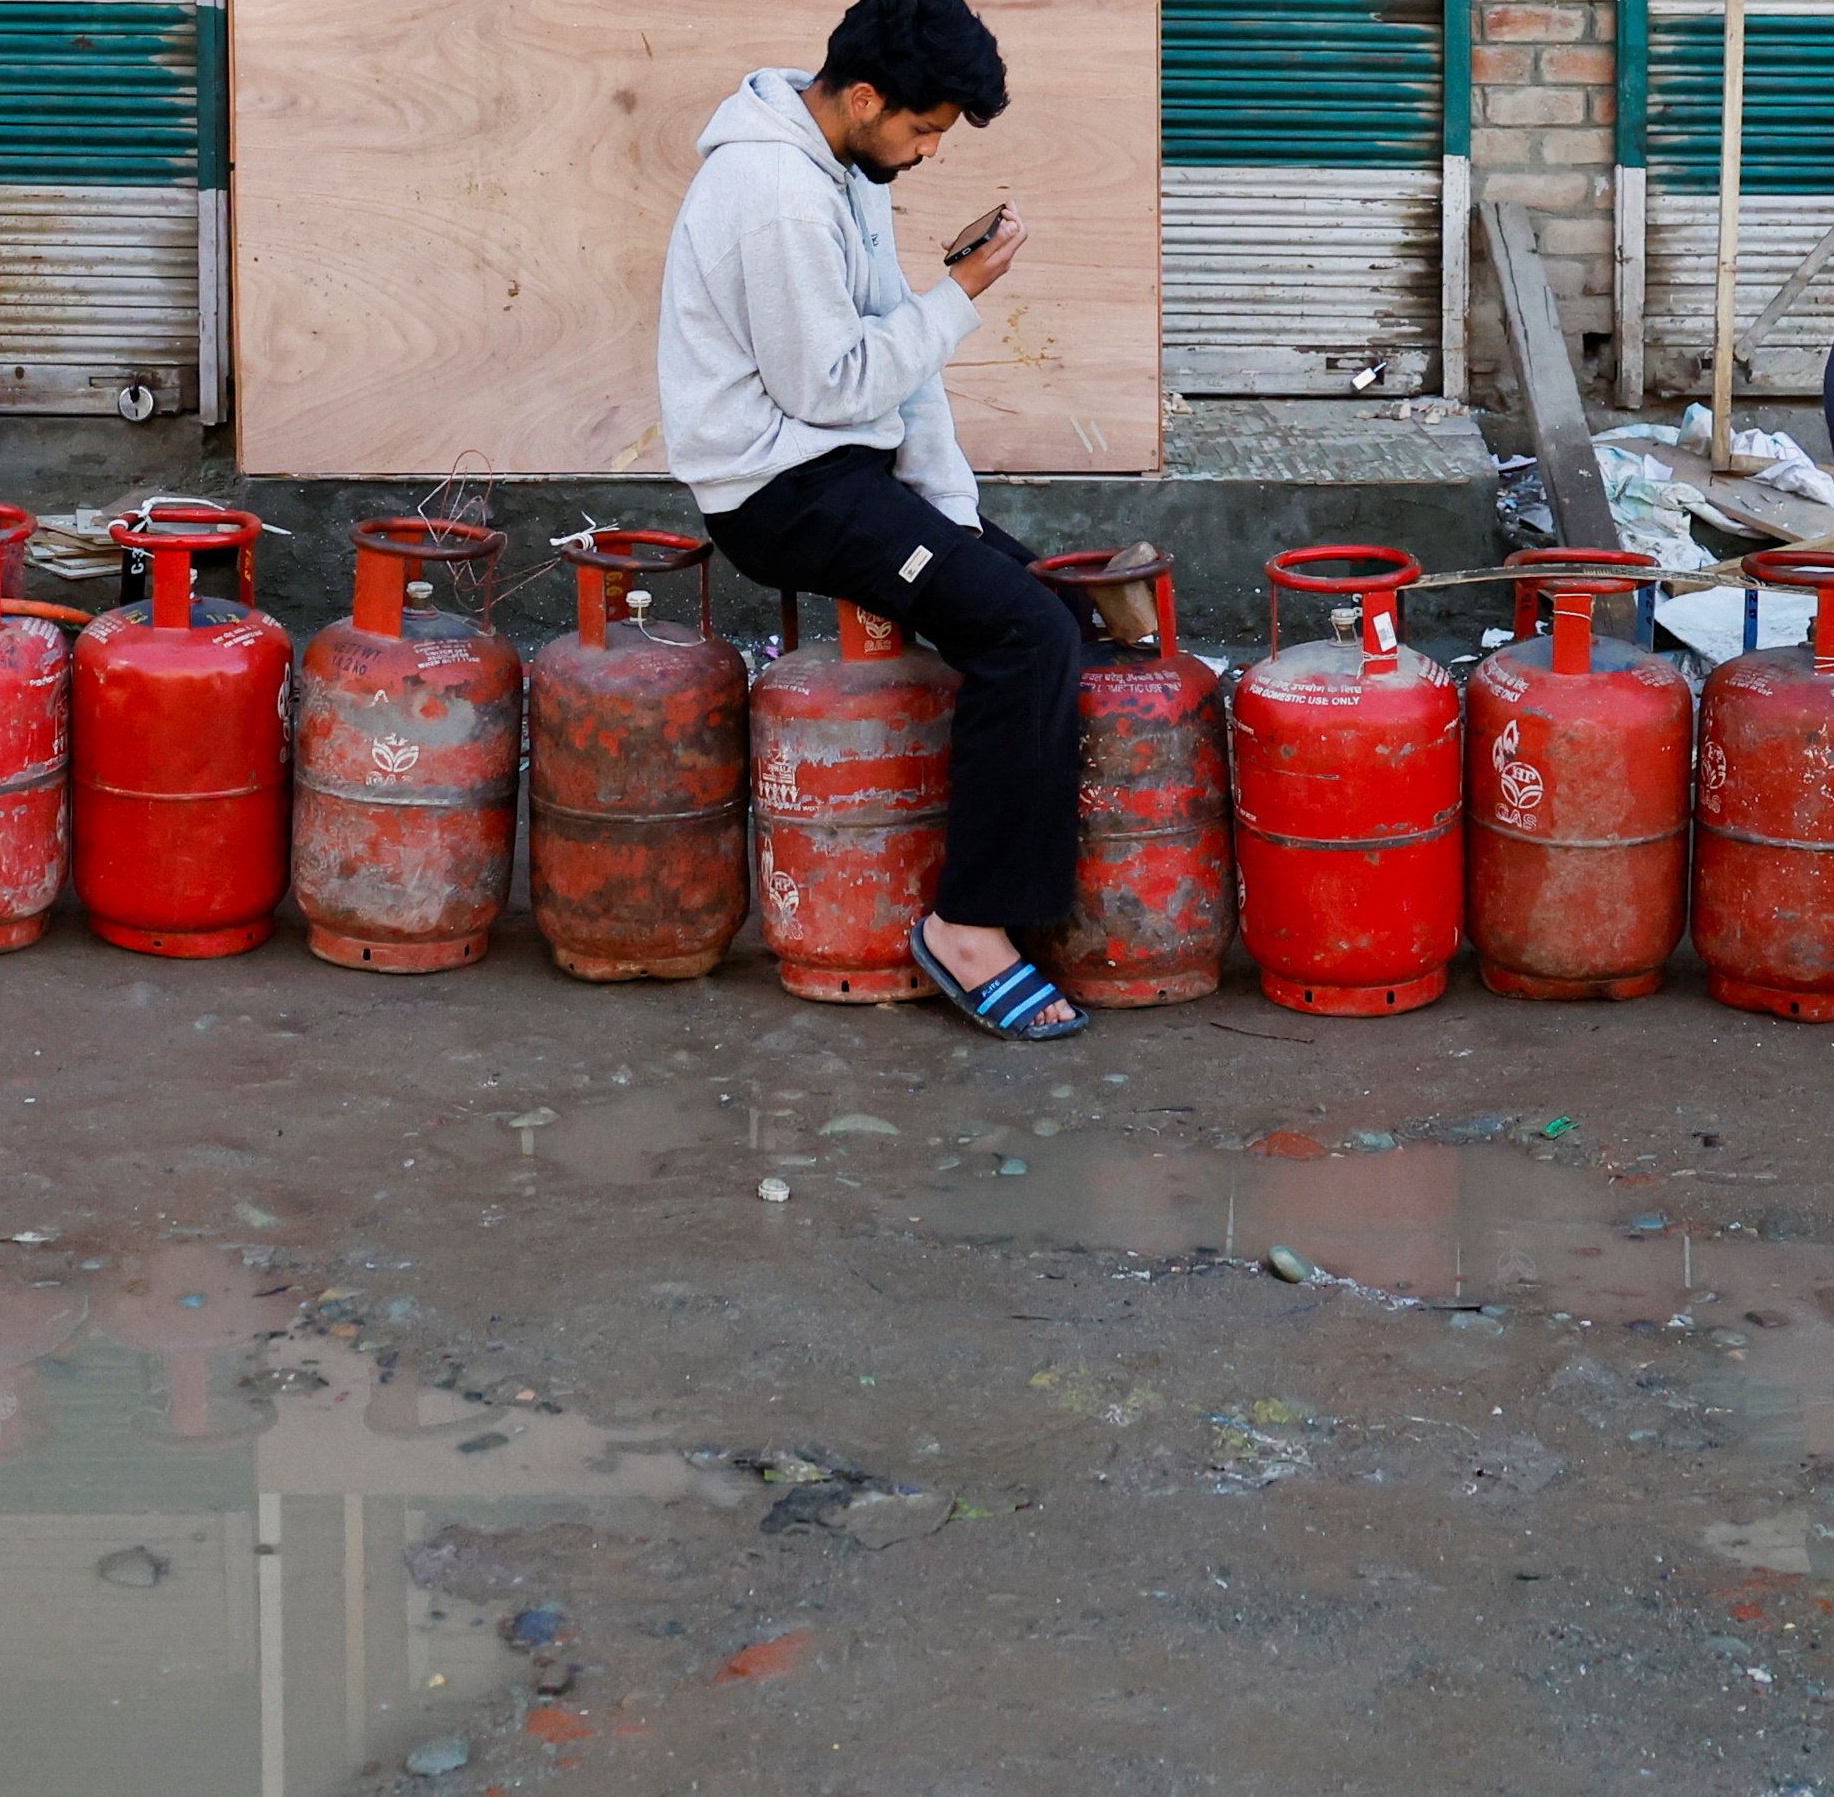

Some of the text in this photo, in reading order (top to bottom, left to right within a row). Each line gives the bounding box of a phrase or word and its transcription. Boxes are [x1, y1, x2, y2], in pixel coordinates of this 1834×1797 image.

[1261, 687, 1306, 705] DOMESTIC
[1307, 695, 1329, 706] USE
[1331, 696, 1361, 706] ONLY
[1512, 768, 1537, 784] HP
[1494, 803, 1539, 832] GAS
